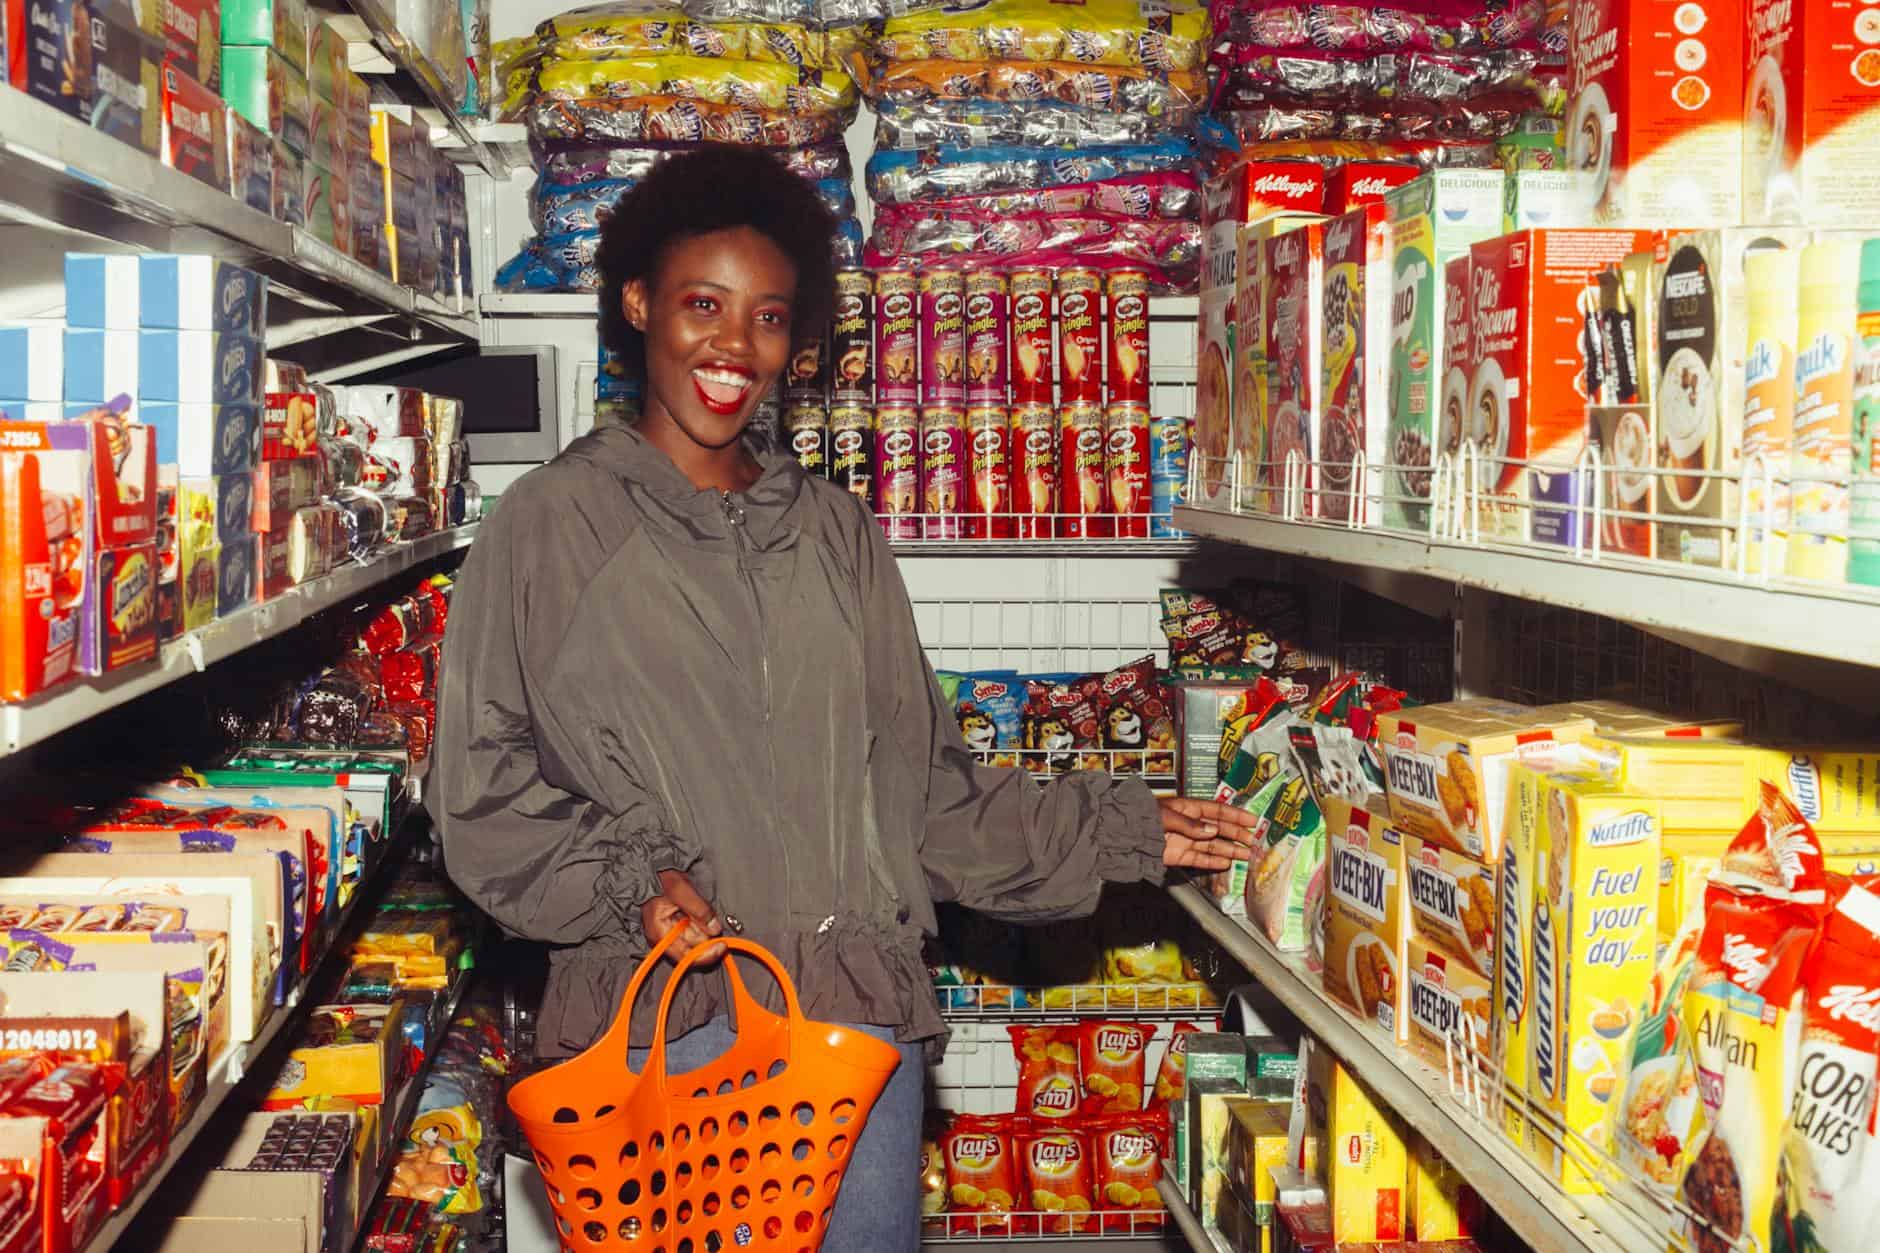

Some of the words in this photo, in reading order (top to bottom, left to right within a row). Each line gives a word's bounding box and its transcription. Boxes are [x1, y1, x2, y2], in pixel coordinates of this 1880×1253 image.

[1254, 173, 1317, 198] Kellogg's
[1015, 317, 1048, 339] Pringles
[1186, 618, 1217, 637] Simba
[975, 685, 1007, 699] Simba
[1105, 672, 1135, 691] Simba
[1051, 693, 1083, 705] Simba
[1389, 753, 1438, 801] WEET-BIX
[1791, 754, 1817, 820] Nutrific
[1590, 814, 1654, 843] Nutrific
[1332, 847, 1384, 912] WEET-BIX
[1409, 865, 1458, 921] WEET-BIX
[1591, 866, 1642, 897] Fuel
[1587, 905, 1647, 937] your
[1504, 843, 1522, 1036] Nutrific
[1588, 941, 1650, 968] day...
[1535, 890, 1553, 1098] Nutrific
[1100, 1030, 1139, 1050] Lay's
[955, 1137, 997, 1160] Lay's
[1036, 1143, 1077, 1164] Lay's
